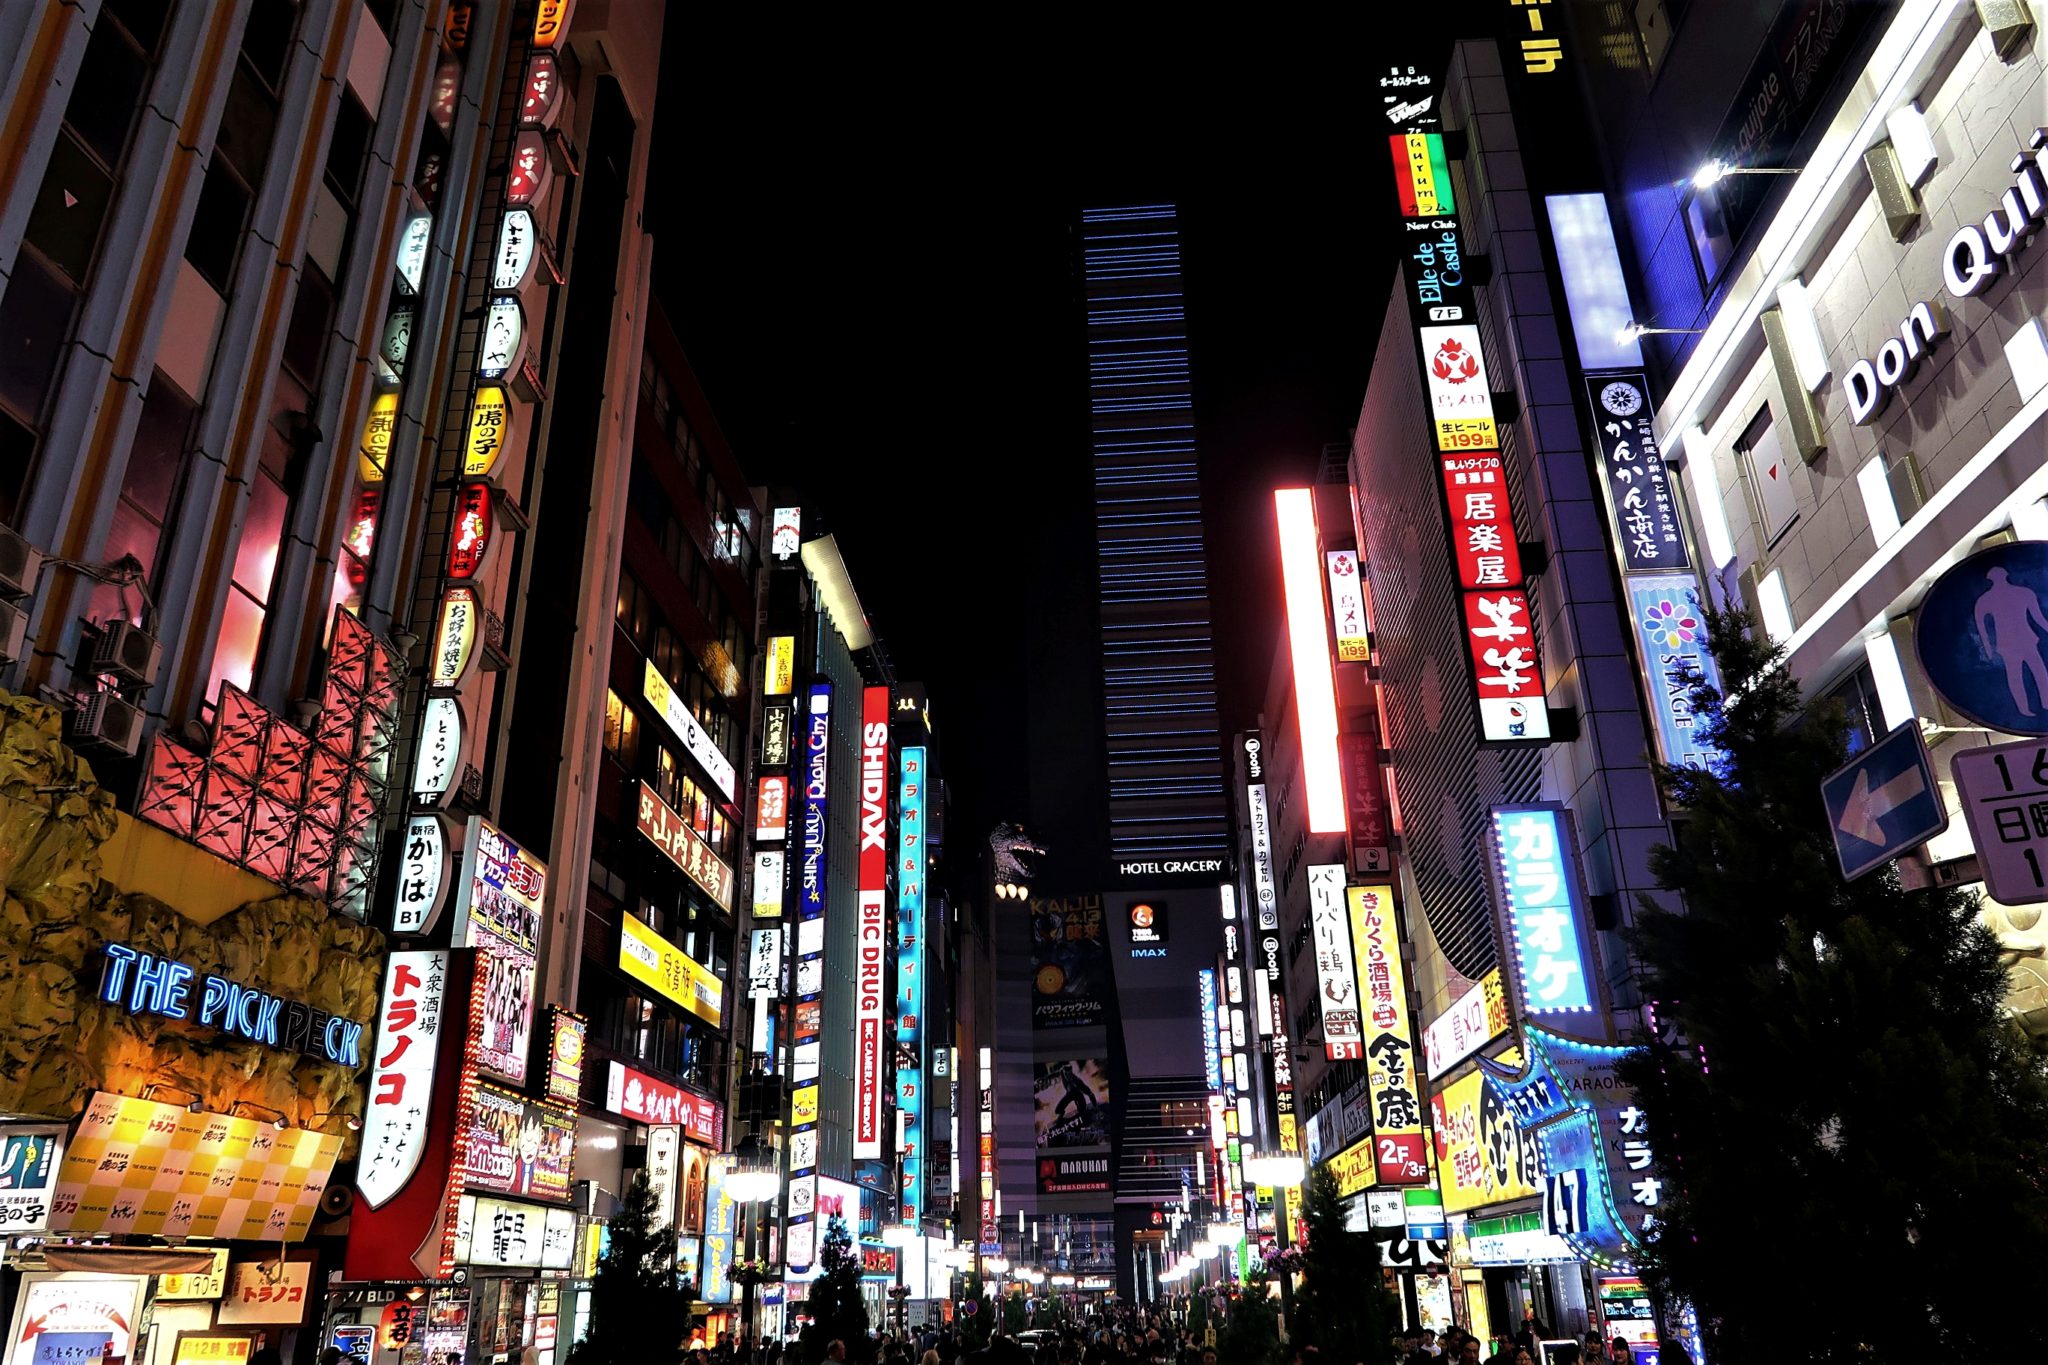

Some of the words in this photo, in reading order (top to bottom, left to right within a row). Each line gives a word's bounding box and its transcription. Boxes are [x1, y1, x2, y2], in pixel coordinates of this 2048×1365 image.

[538, 0, 560, 34] ック
[1408, 203, 1448, 214] ガラム
[1406, 222, 1430, 232] New
[1431, 220, 1457, 230] Club
[1413, 242, 1435, 266] de
[1436, 231, 1463, 287] Castle
[1417, 267, 1443, 304] Elle
[1434, 309, 1459, 320] 7F
[485, 369, 500, 378] 5F
[1842, 301, 1944, 426] Don
[472, 410, 503, 455] 虎の子
[1441, 421, 1490, 434] 生ビール
[465, 462, 486, 474] 4F
[1605, 419, 1660, 559] かんかん商店
[1465, 493, 1510, 586] 居楽屋
[442, 604, 467, 677] お好み焼き
[1344, 646, 1367, 657] 199
[1471, 595, 1535, 696] 笑笑
[649, 674, 665, 706] 3F
[1660, 654, 1694, 729] STAGE
[1245, 739, 1262, 778] Booth
[418, 792, 438, 804] 1F
[862, 722, 889, 853] SHIDAX
[1253, 789, 1265, 836] ネットカフェ
[410, 825, 436, 837] 新宿
[480, 827, 510, 864] 出会い
[1257, 839, 1266, 847] &
[653, 805, 722, 899] 山内農場
[803, 811, 820, 890] SHINJUKU
[1120, 862, 1162, 874] HOTEL
[1164, 860, 1222, 873] GRACERY
[1258, 850, 1269, 883] カプセル
[485, 860, 507, 885] カフェ
[507, 856, 544, 902] キラリ
[400, 910, 422, 924] B1
[760, 904, 775, 914] 3F
[863, 903, 880, 941] BIC
[1030, 895, 1100, 916] KAIJU
[1065, 910, 1100, 923] 4.13
[1508, 817, 1578, 1001] カラオケ
[1132, 948, 1167, 958] IMAX
[1263, 938, 1280, 981] Booth
[1362, 892, 1393, 1003] きんくら酒場
[418, 954, 445, 1036] 大衆酒場
[861, 946, 880, 1012] DRUG
[104, 943, 194, 1019] THE
[199, 972, 282, 1045] PICK
[283, 999, 363, 1069] PECK
[375, 964, 421, 1106] トラノコ
[864, 1022, 874, 1040] BIC
[864, 1041, 874, 1087] CAMERA
[1333, 1042, 1358, 1059] B1
[1277, 1092, 1292, 1102] 4F
[1368, 1032, 1420, 1130] 金の蔵
[1278, 1103, 1293, 1112] 3F
[1507, 1079, 1555, 1119] カラオケ
[147, 1119, 177, 1134] トラノコ
[391, 1106, 421, 1168] やきとり
[99, 1159, 128, 1172] 虎の子
[366, 1119, 398, 1182] やきとん
[1061, 1159, 1108, 1174] MARUHAN
[1380, 1138, 1410, 1164] 2F
[1370, 1201, 1398, 1215] 築地
[1534, 1168, 1588, 1235] 747
[187, 1277, 219, 1296] 190円
[243, 1286, 302, 1304] トラノコ
[367, 1290, 395, 1302] BLD
[391, 1304, 413, 1342] 立呑
